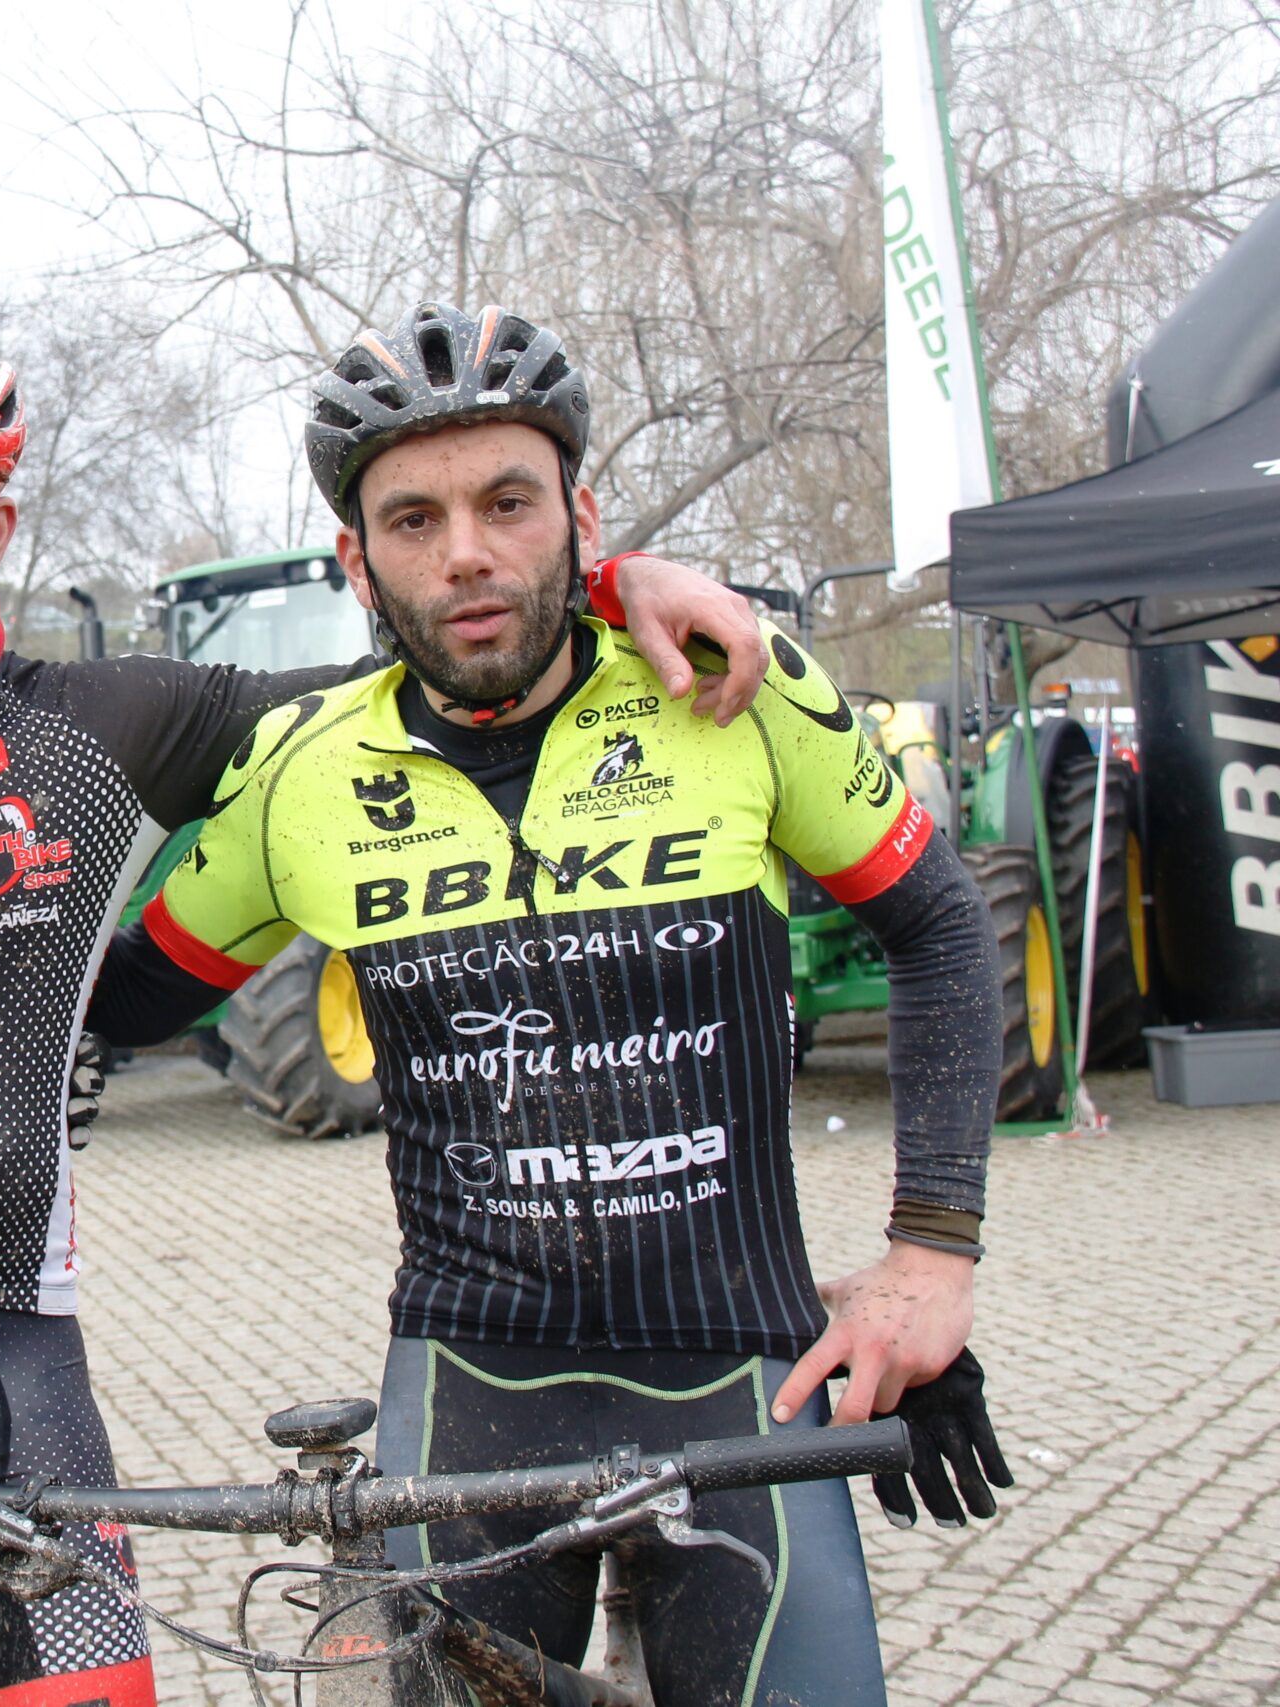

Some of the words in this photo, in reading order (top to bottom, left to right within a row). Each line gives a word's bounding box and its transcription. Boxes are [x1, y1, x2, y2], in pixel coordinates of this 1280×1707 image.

[605, 696, 659, 716] PACTO
[563, 787, 612, 804] VELO
[616, 775, 674, 796] CLUBE
[562, 790, 674, 818] BRAGANÇA
[355, 829, 709, 929] BBIKE
[614, 1073, 667, 1090] 1996
[463, 1194, 483, 1213] Z.
[487, 1198, 558, 1220] SOUSA
[564, 1200, 580, 1218] &
[593, 1189, 682, 1218] CAMILO,
[687, 1180, 727, 1203] LDA.
